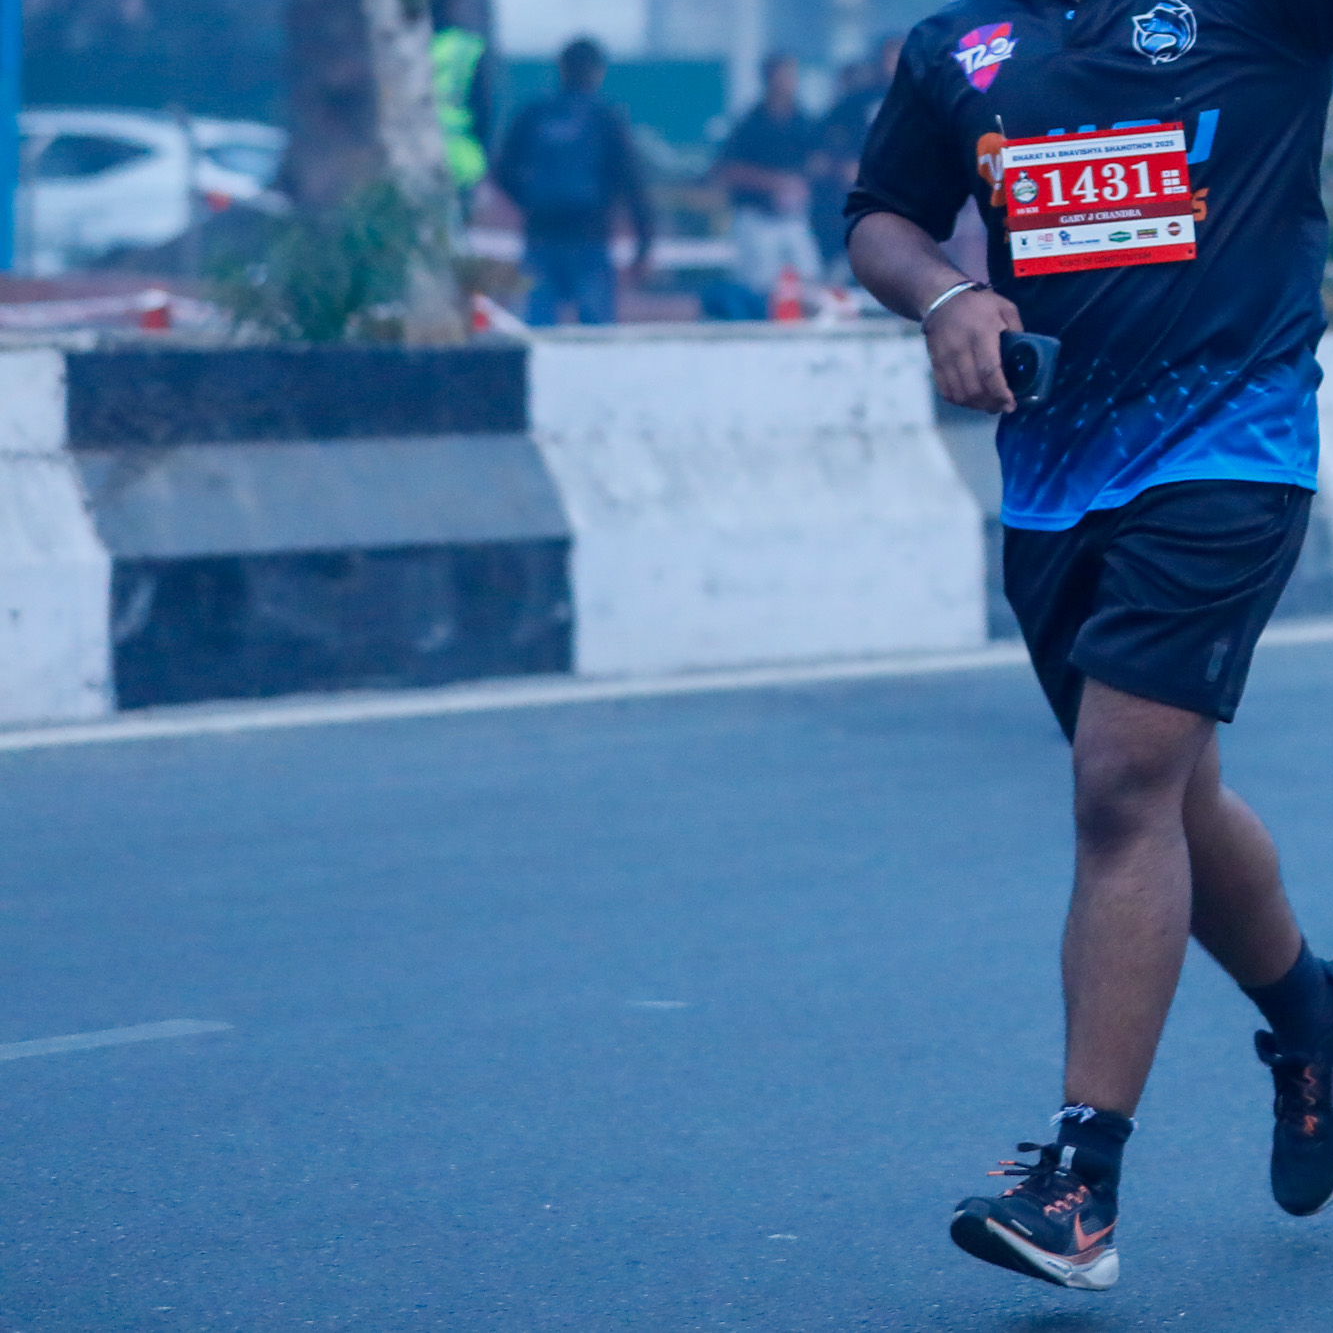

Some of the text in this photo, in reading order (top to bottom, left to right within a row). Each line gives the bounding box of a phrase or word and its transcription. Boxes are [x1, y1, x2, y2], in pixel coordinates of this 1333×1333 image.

[1012, 152, 1044, 162] BHARAT
[1058, 146, 1102, 158] BHAVISHYA
[1155, 139, 1175, 148] 2025
[1042, 160, 1158, 207] 1431
[1095, 209, 1142, 220] CHANDRA
